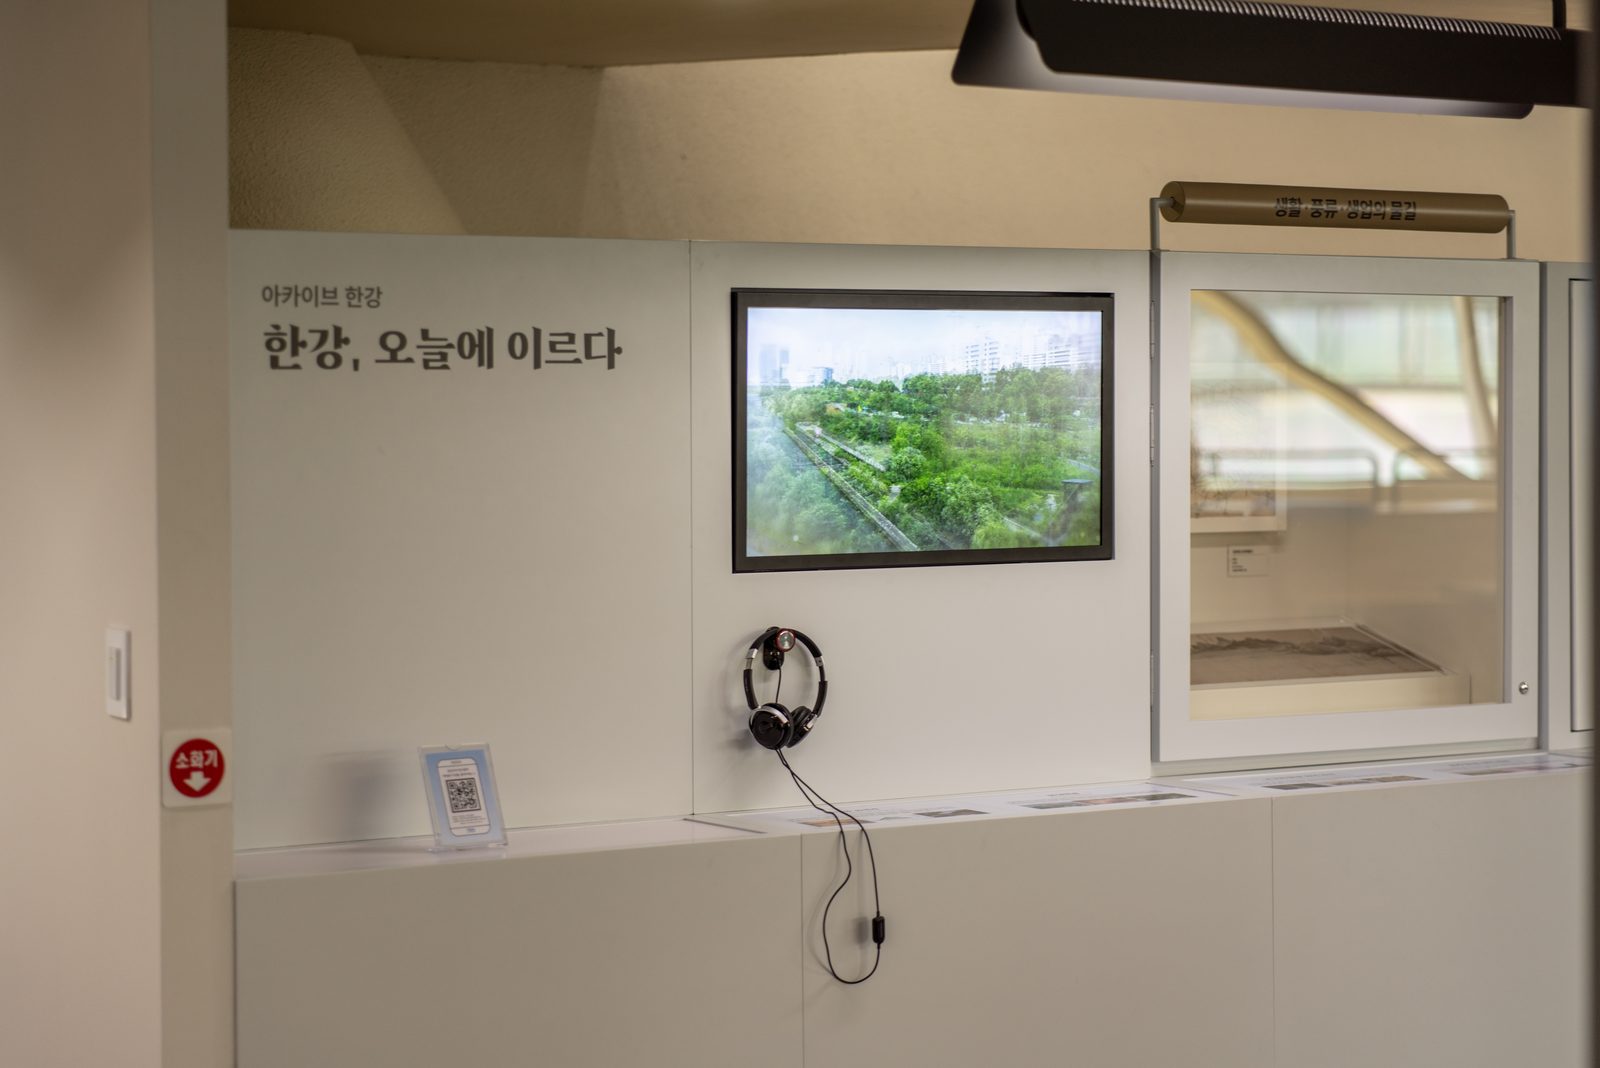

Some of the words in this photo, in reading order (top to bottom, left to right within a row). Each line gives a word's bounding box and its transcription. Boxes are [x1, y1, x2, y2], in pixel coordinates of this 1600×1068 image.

[1390, 201, 1417, 221] 물길
[261, 285, 340, 308] 아카이브
[344, 286, 384, 309] 한강
[263, 324, 360, 372] 한강,
[374, 326, 495, 370] 오늘에
[507, 326, 623, 370] 이르다
[175, 749, 219, 769] 소화기
